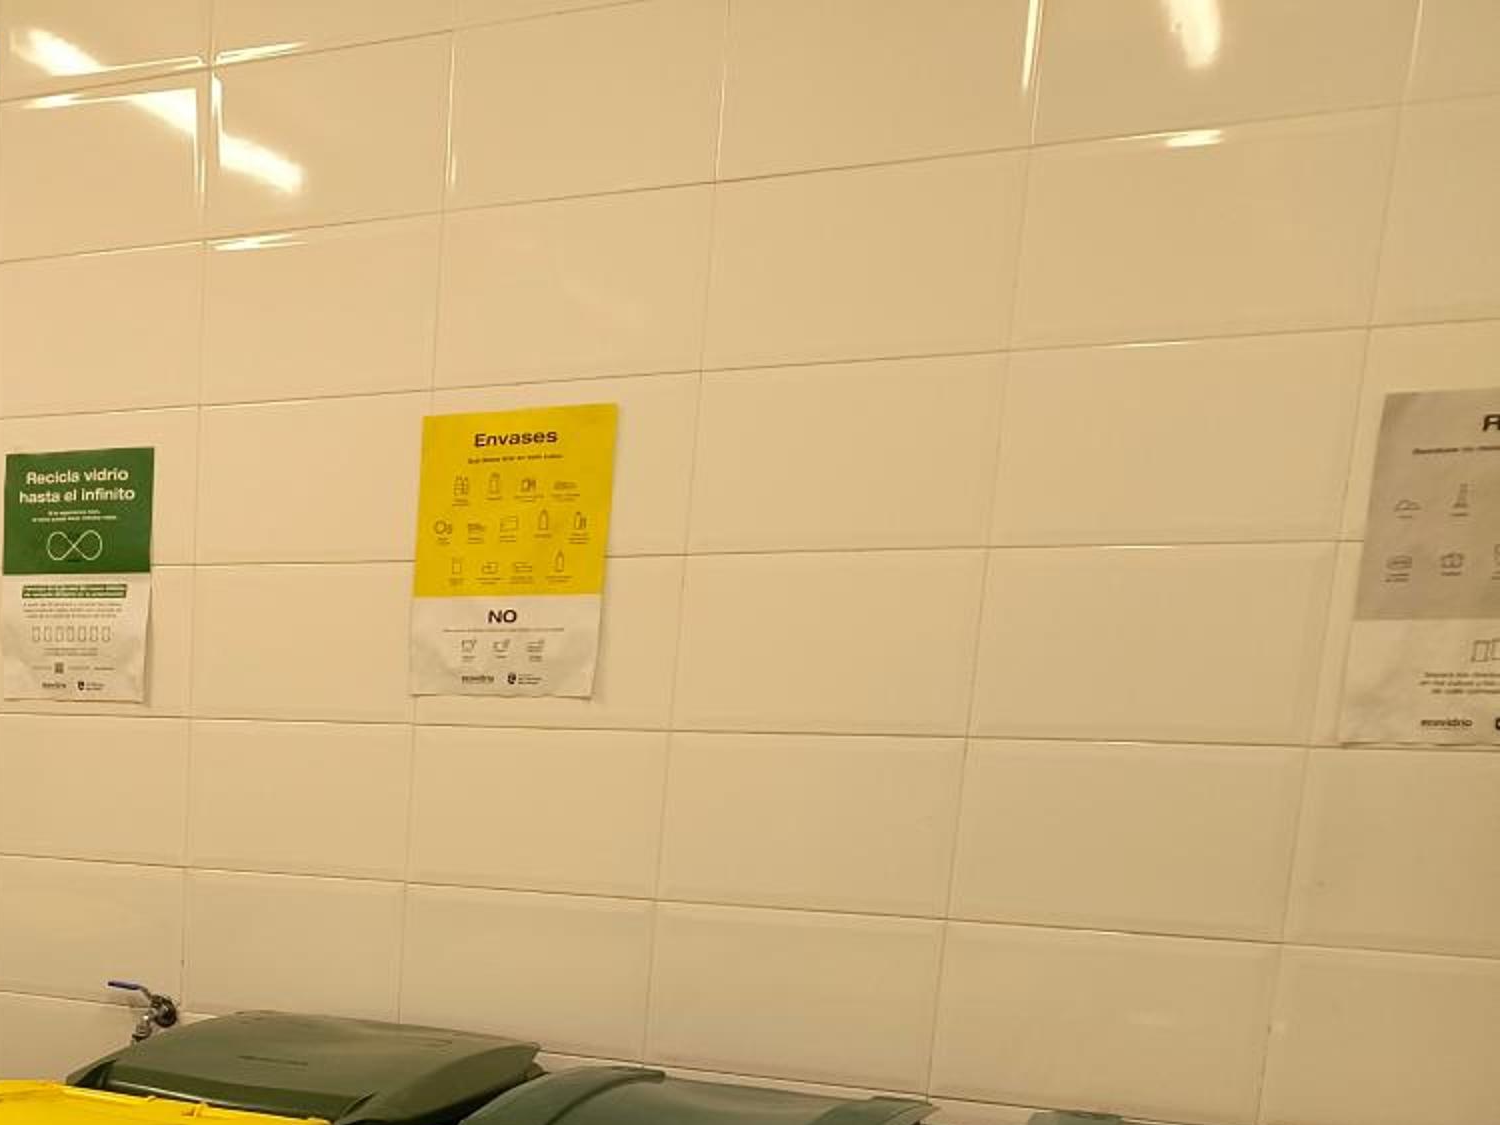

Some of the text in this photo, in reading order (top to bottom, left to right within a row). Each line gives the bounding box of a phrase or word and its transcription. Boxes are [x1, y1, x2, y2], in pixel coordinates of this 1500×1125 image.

[474, 431, 558, 448] Envases
[26, 467, 129, 485] Recicla vidrio
[19, 486, 135, 503] hasta el infinito
[487, 609, 517, 624] NO
